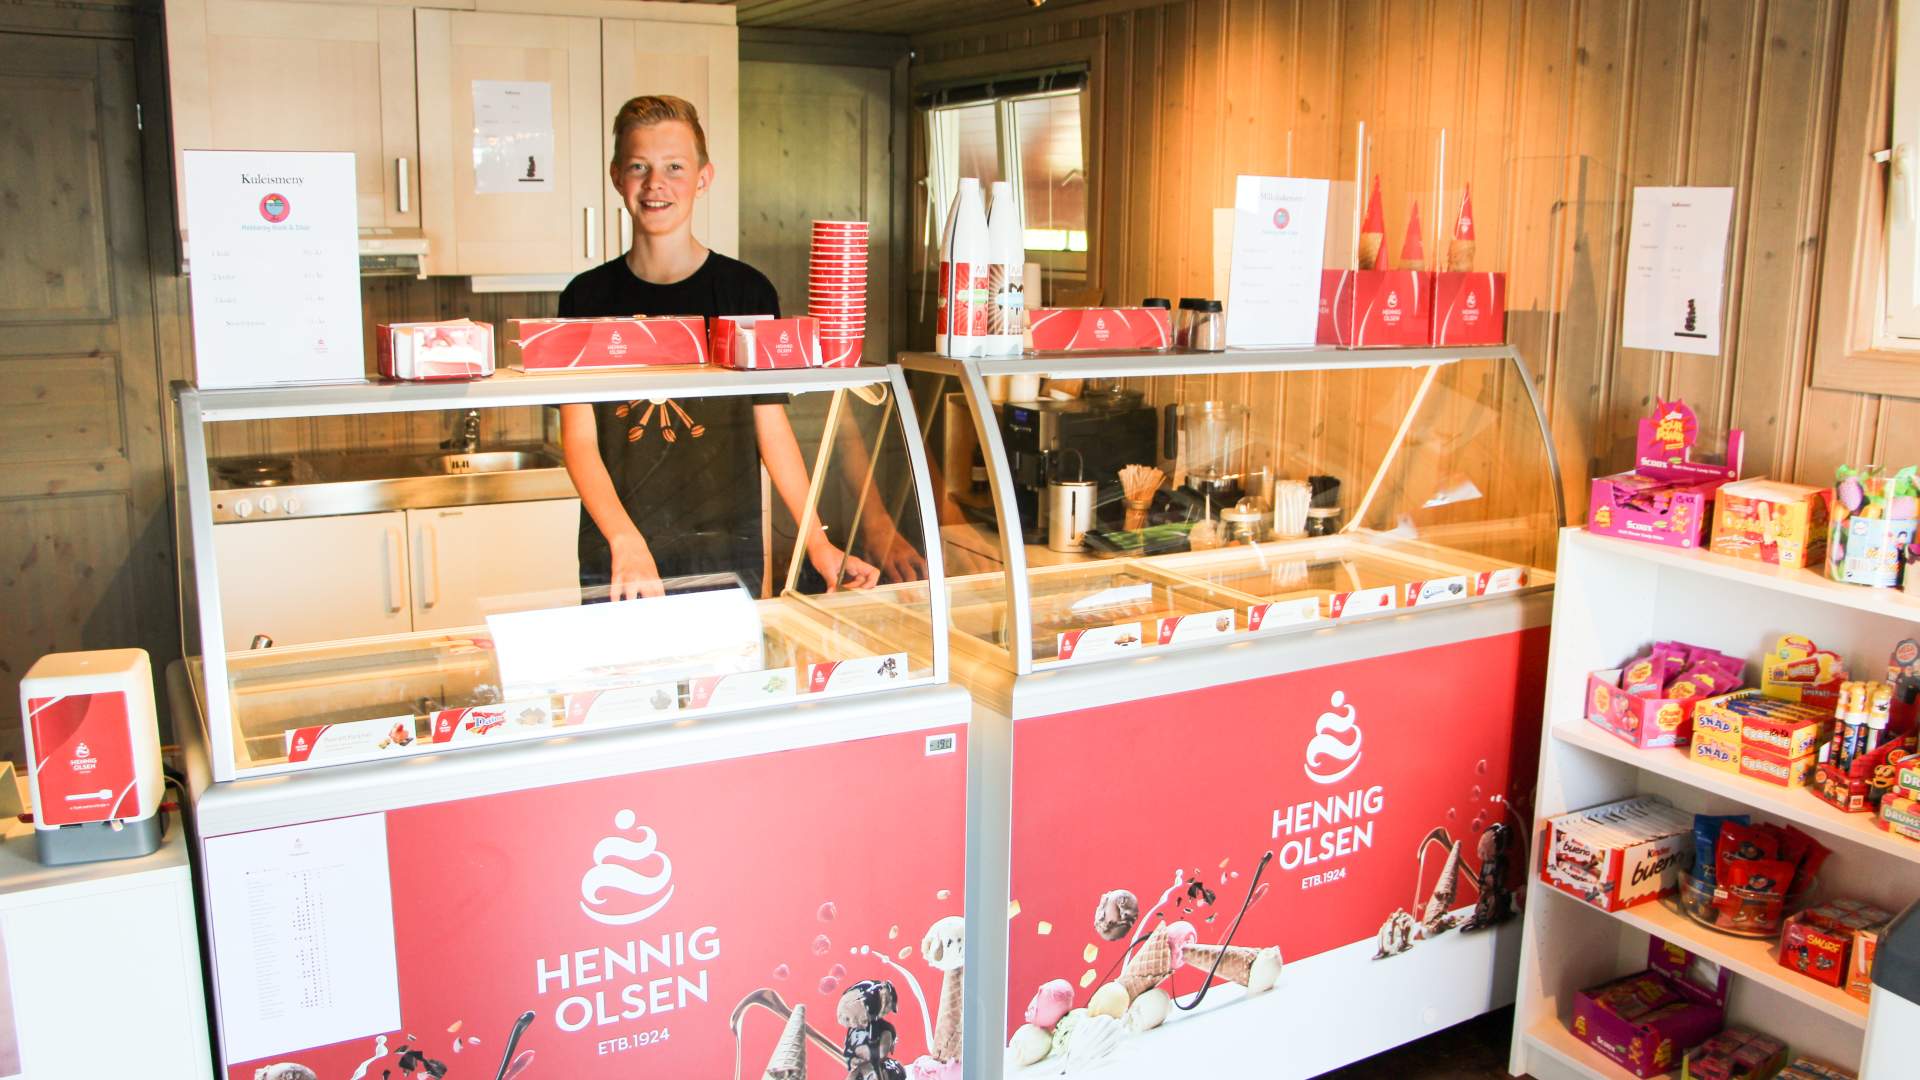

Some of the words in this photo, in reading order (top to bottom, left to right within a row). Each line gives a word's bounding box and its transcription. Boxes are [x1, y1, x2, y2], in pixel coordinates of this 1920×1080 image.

[1699, 716, 1731, 732] SNAP
[1697, 744, 1729, 761] SNAP
[1271, 785, 1384, 839] HENNIG
[1279, 820, 1374, 870] OLSEN
[1563, 841, 1591, 856] bueno
[1301, 867, 1346, 889] ETB.1924
[536, 925, 720, 994] HENNIG
[555, 969, 708, 1032] OLSEN
[598, 1027, 670, 1056] ETB.1924
